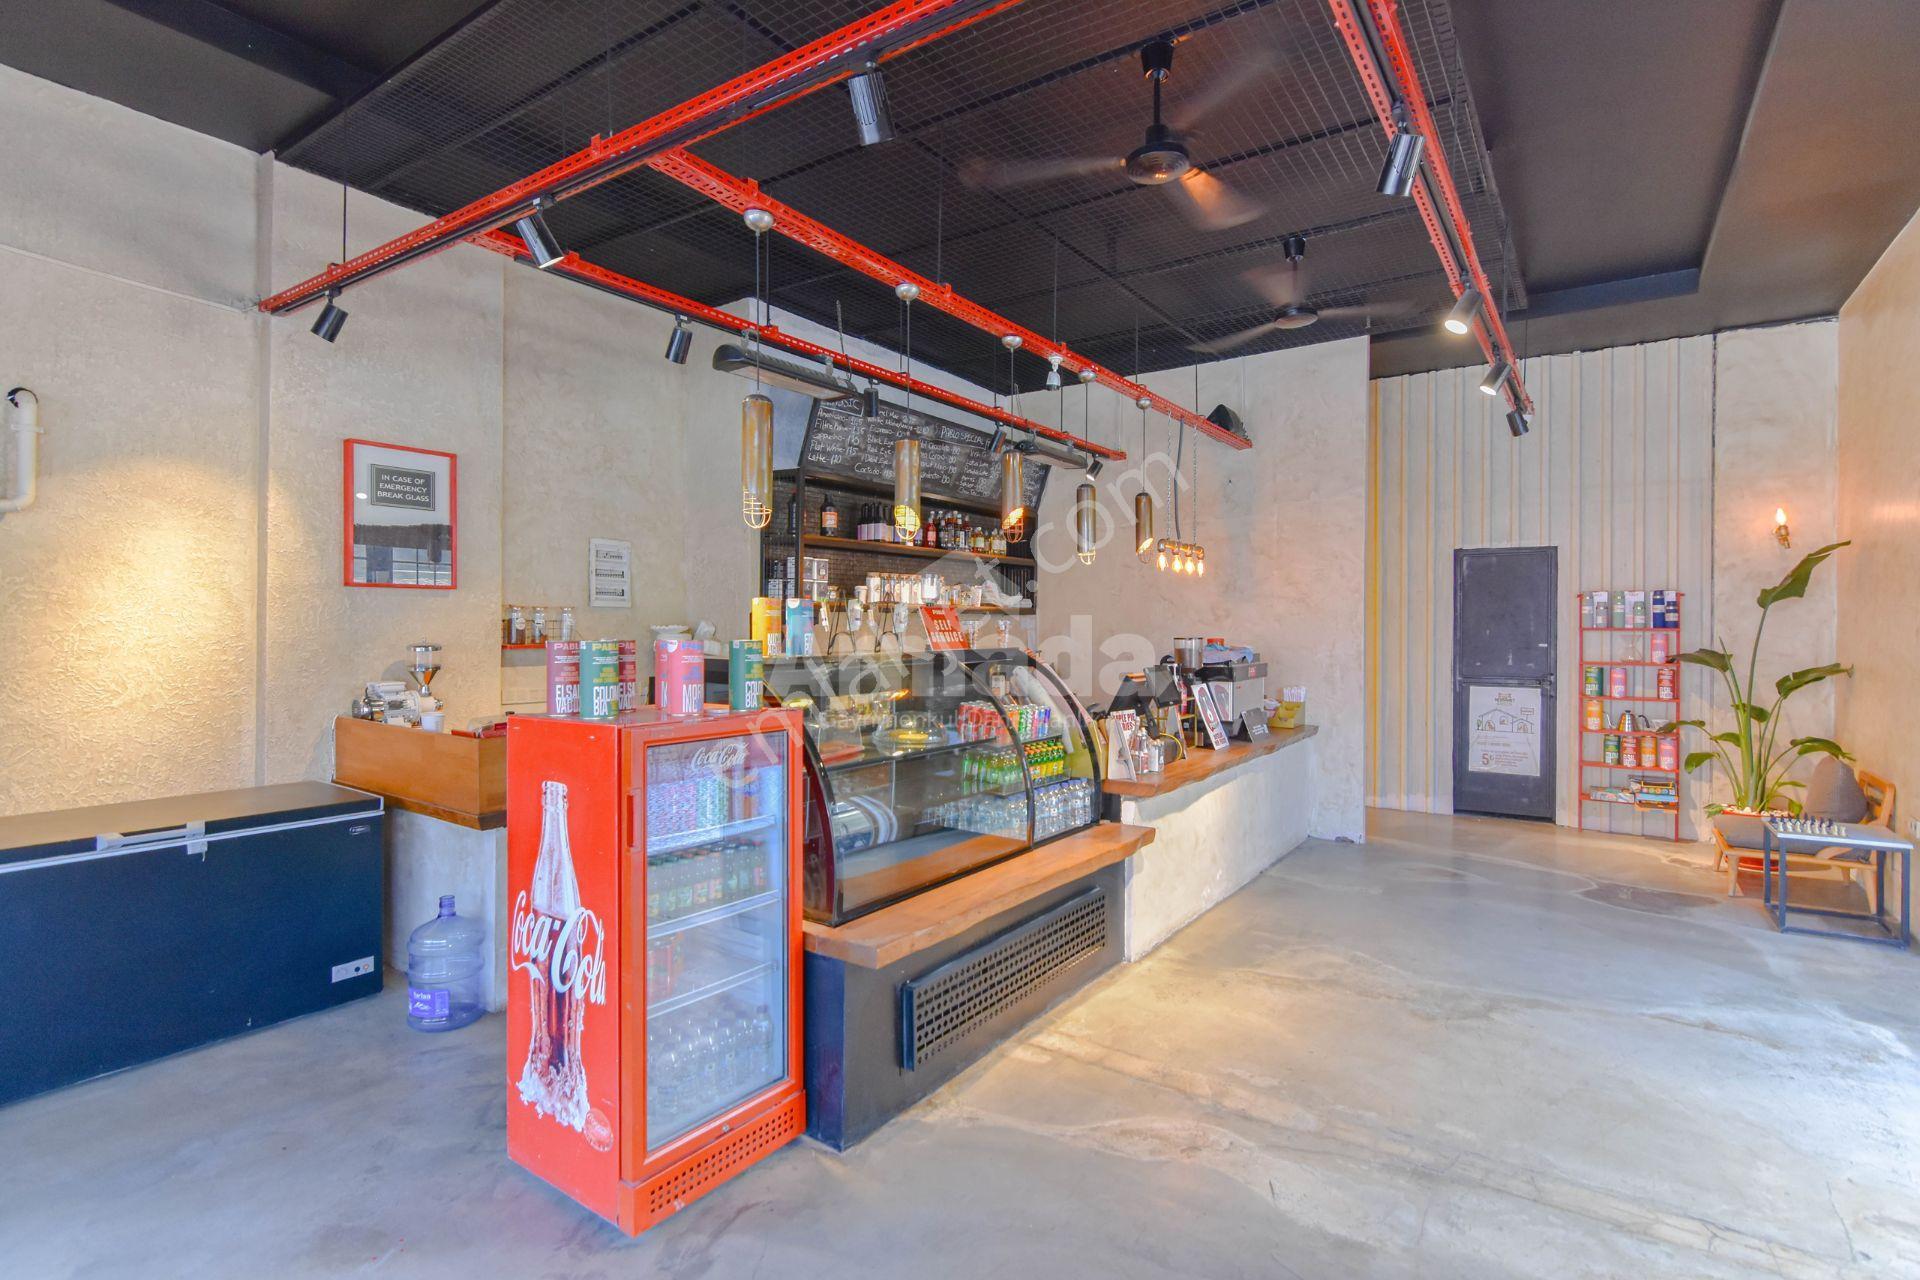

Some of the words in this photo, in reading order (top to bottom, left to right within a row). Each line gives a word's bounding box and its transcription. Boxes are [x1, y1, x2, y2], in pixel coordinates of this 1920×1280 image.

[381, 473, 391, 482] IN
[392, 475, 413, 484] CASE
[379, 482, 428, 494] EMERGENCY
[377, 491, 404, 500] BREAK
[405, 494, 430, 502] GLASS
[934, 619, 952, 631] SELF
[930, 631, 964, 643] SERVICE
[553, 642, 580, 651] PABL
[593, 700, 609, 716] BIA
[511, 890, 606, 1006] Coca-Cola
